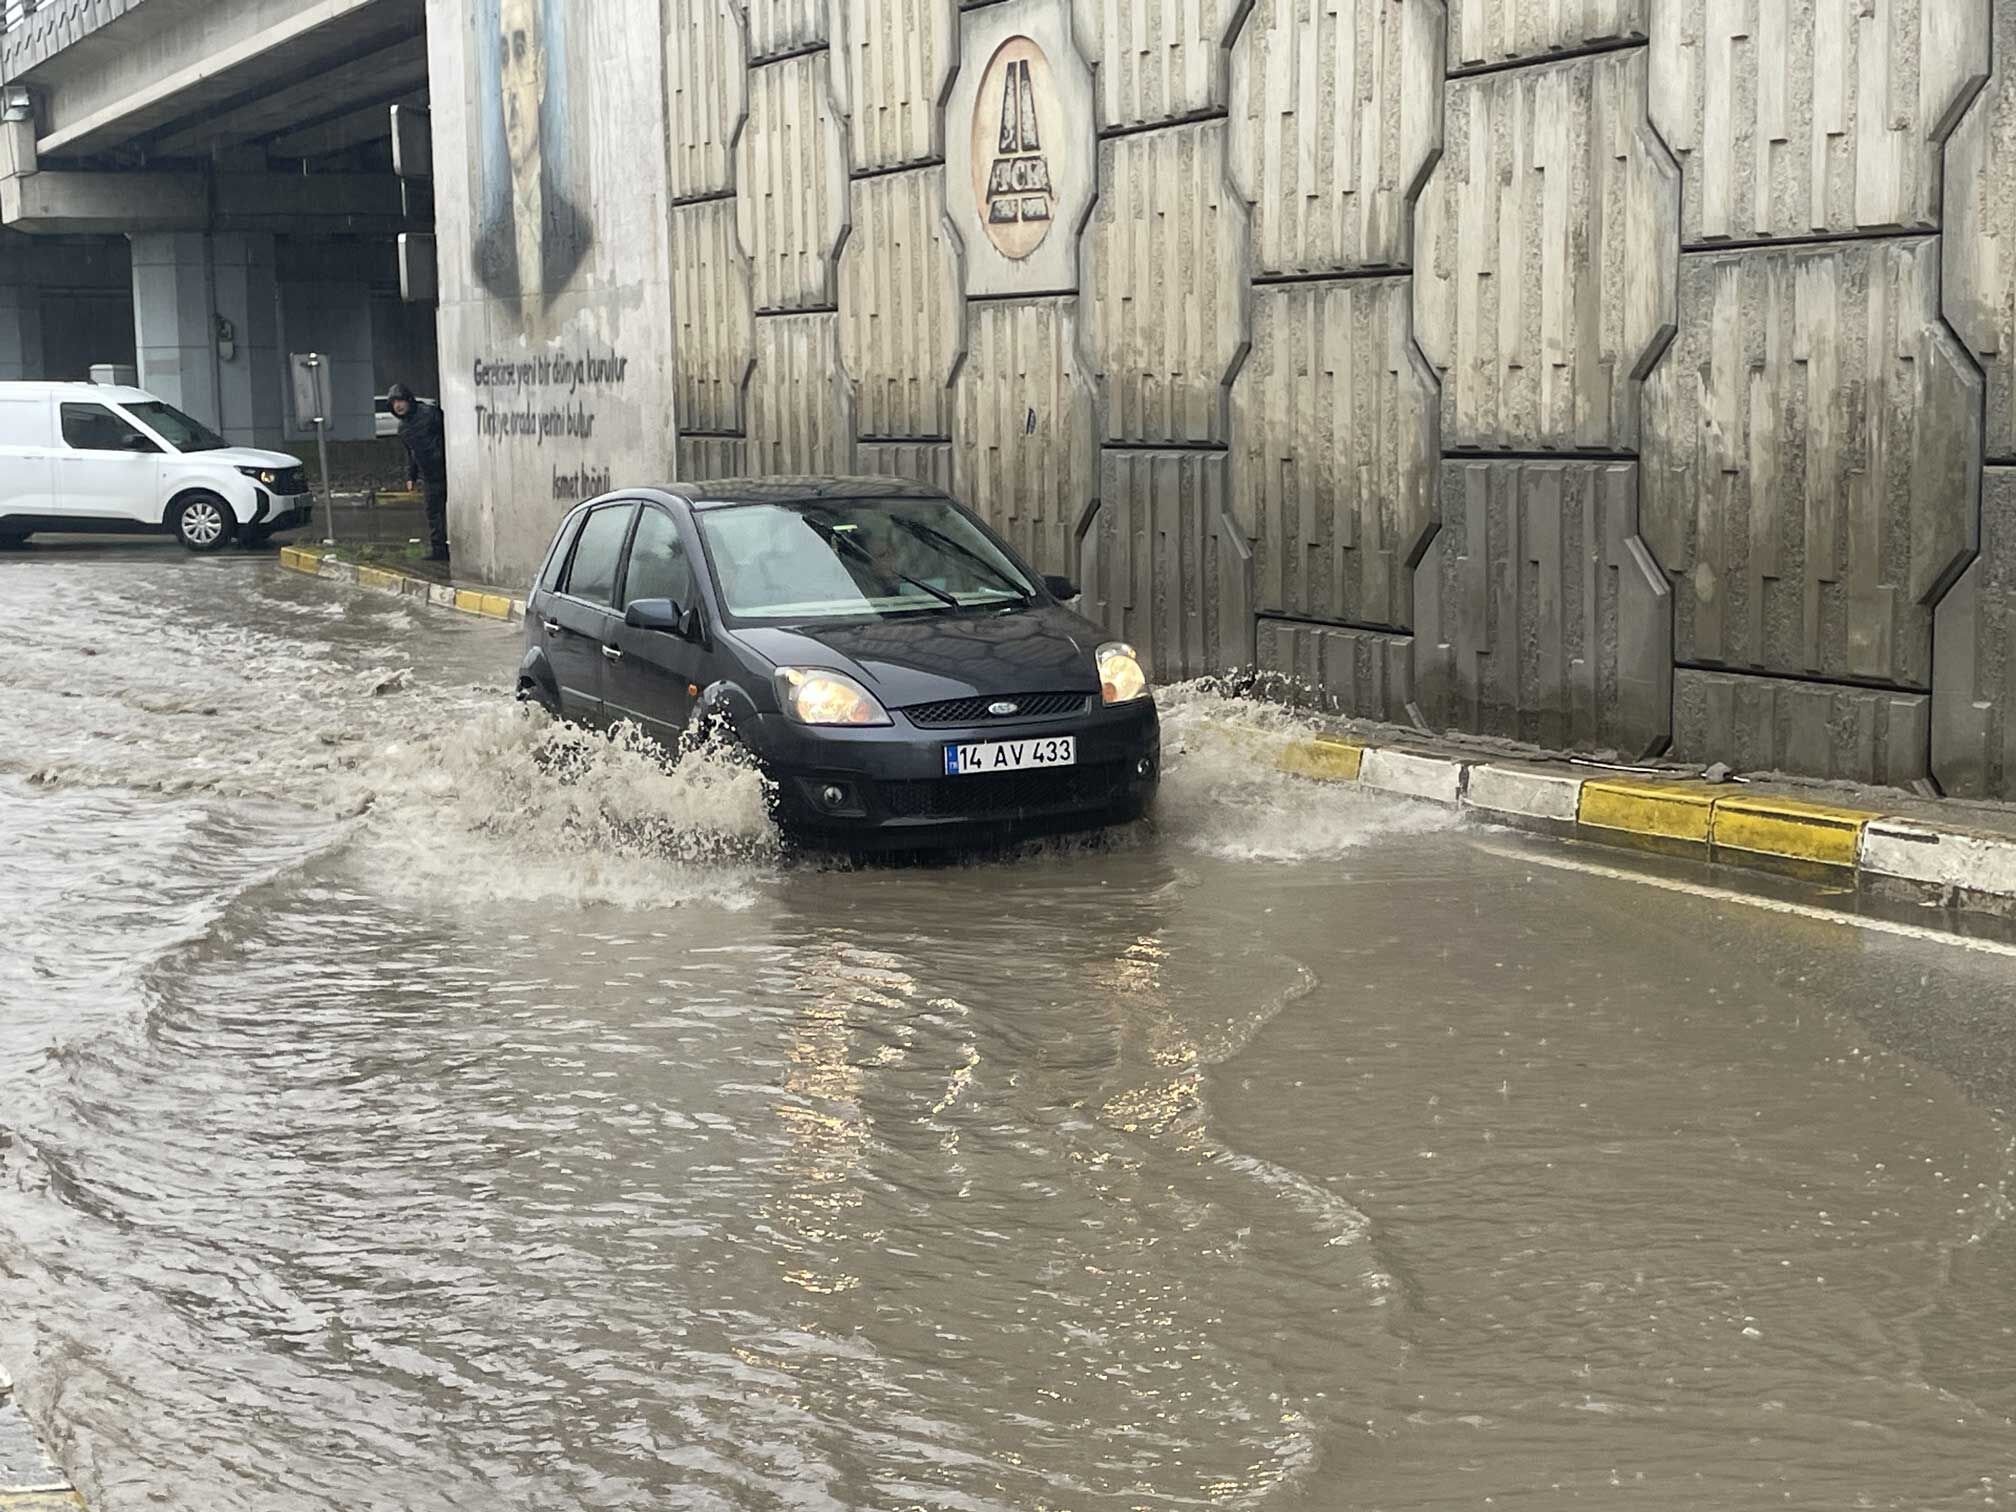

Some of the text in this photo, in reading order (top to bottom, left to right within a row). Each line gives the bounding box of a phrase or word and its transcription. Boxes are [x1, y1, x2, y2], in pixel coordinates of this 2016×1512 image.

[516, 355, 537, 395] yeni
[538, 355, 551, 386] bir
[552, 353, 584, 395] dünya
[586, 349, 627, 384] kurulur
[537, 405, 565, 446] yerini
[566, 400, 595, 439] bulur
[959, 740, 1071, 770] 14 AV 433
